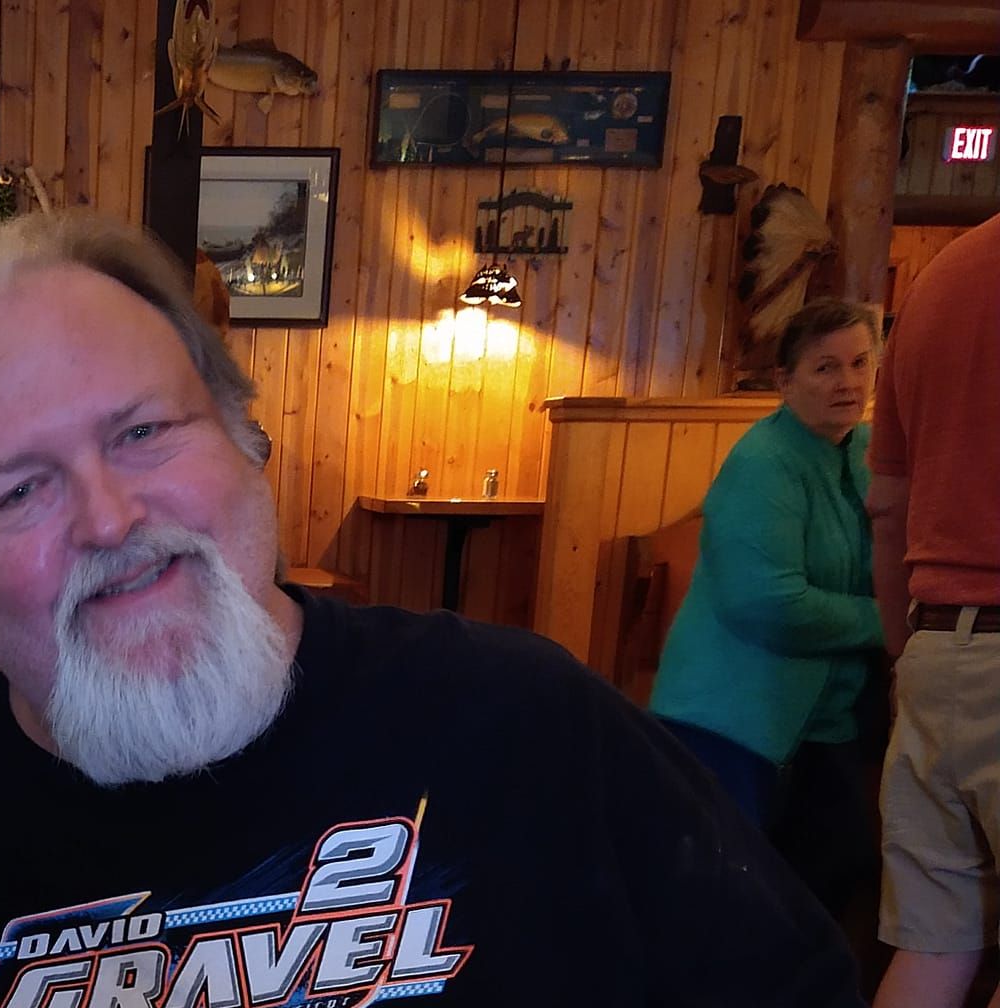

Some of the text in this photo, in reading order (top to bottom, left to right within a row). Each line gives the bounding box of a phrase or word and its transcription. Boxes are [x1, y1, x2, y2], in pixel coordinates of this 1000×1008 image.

[951, 127, 993, 160] EXIT
[303, 823, 410, 912] 2
[17, 912, 164, 960] DAVID
